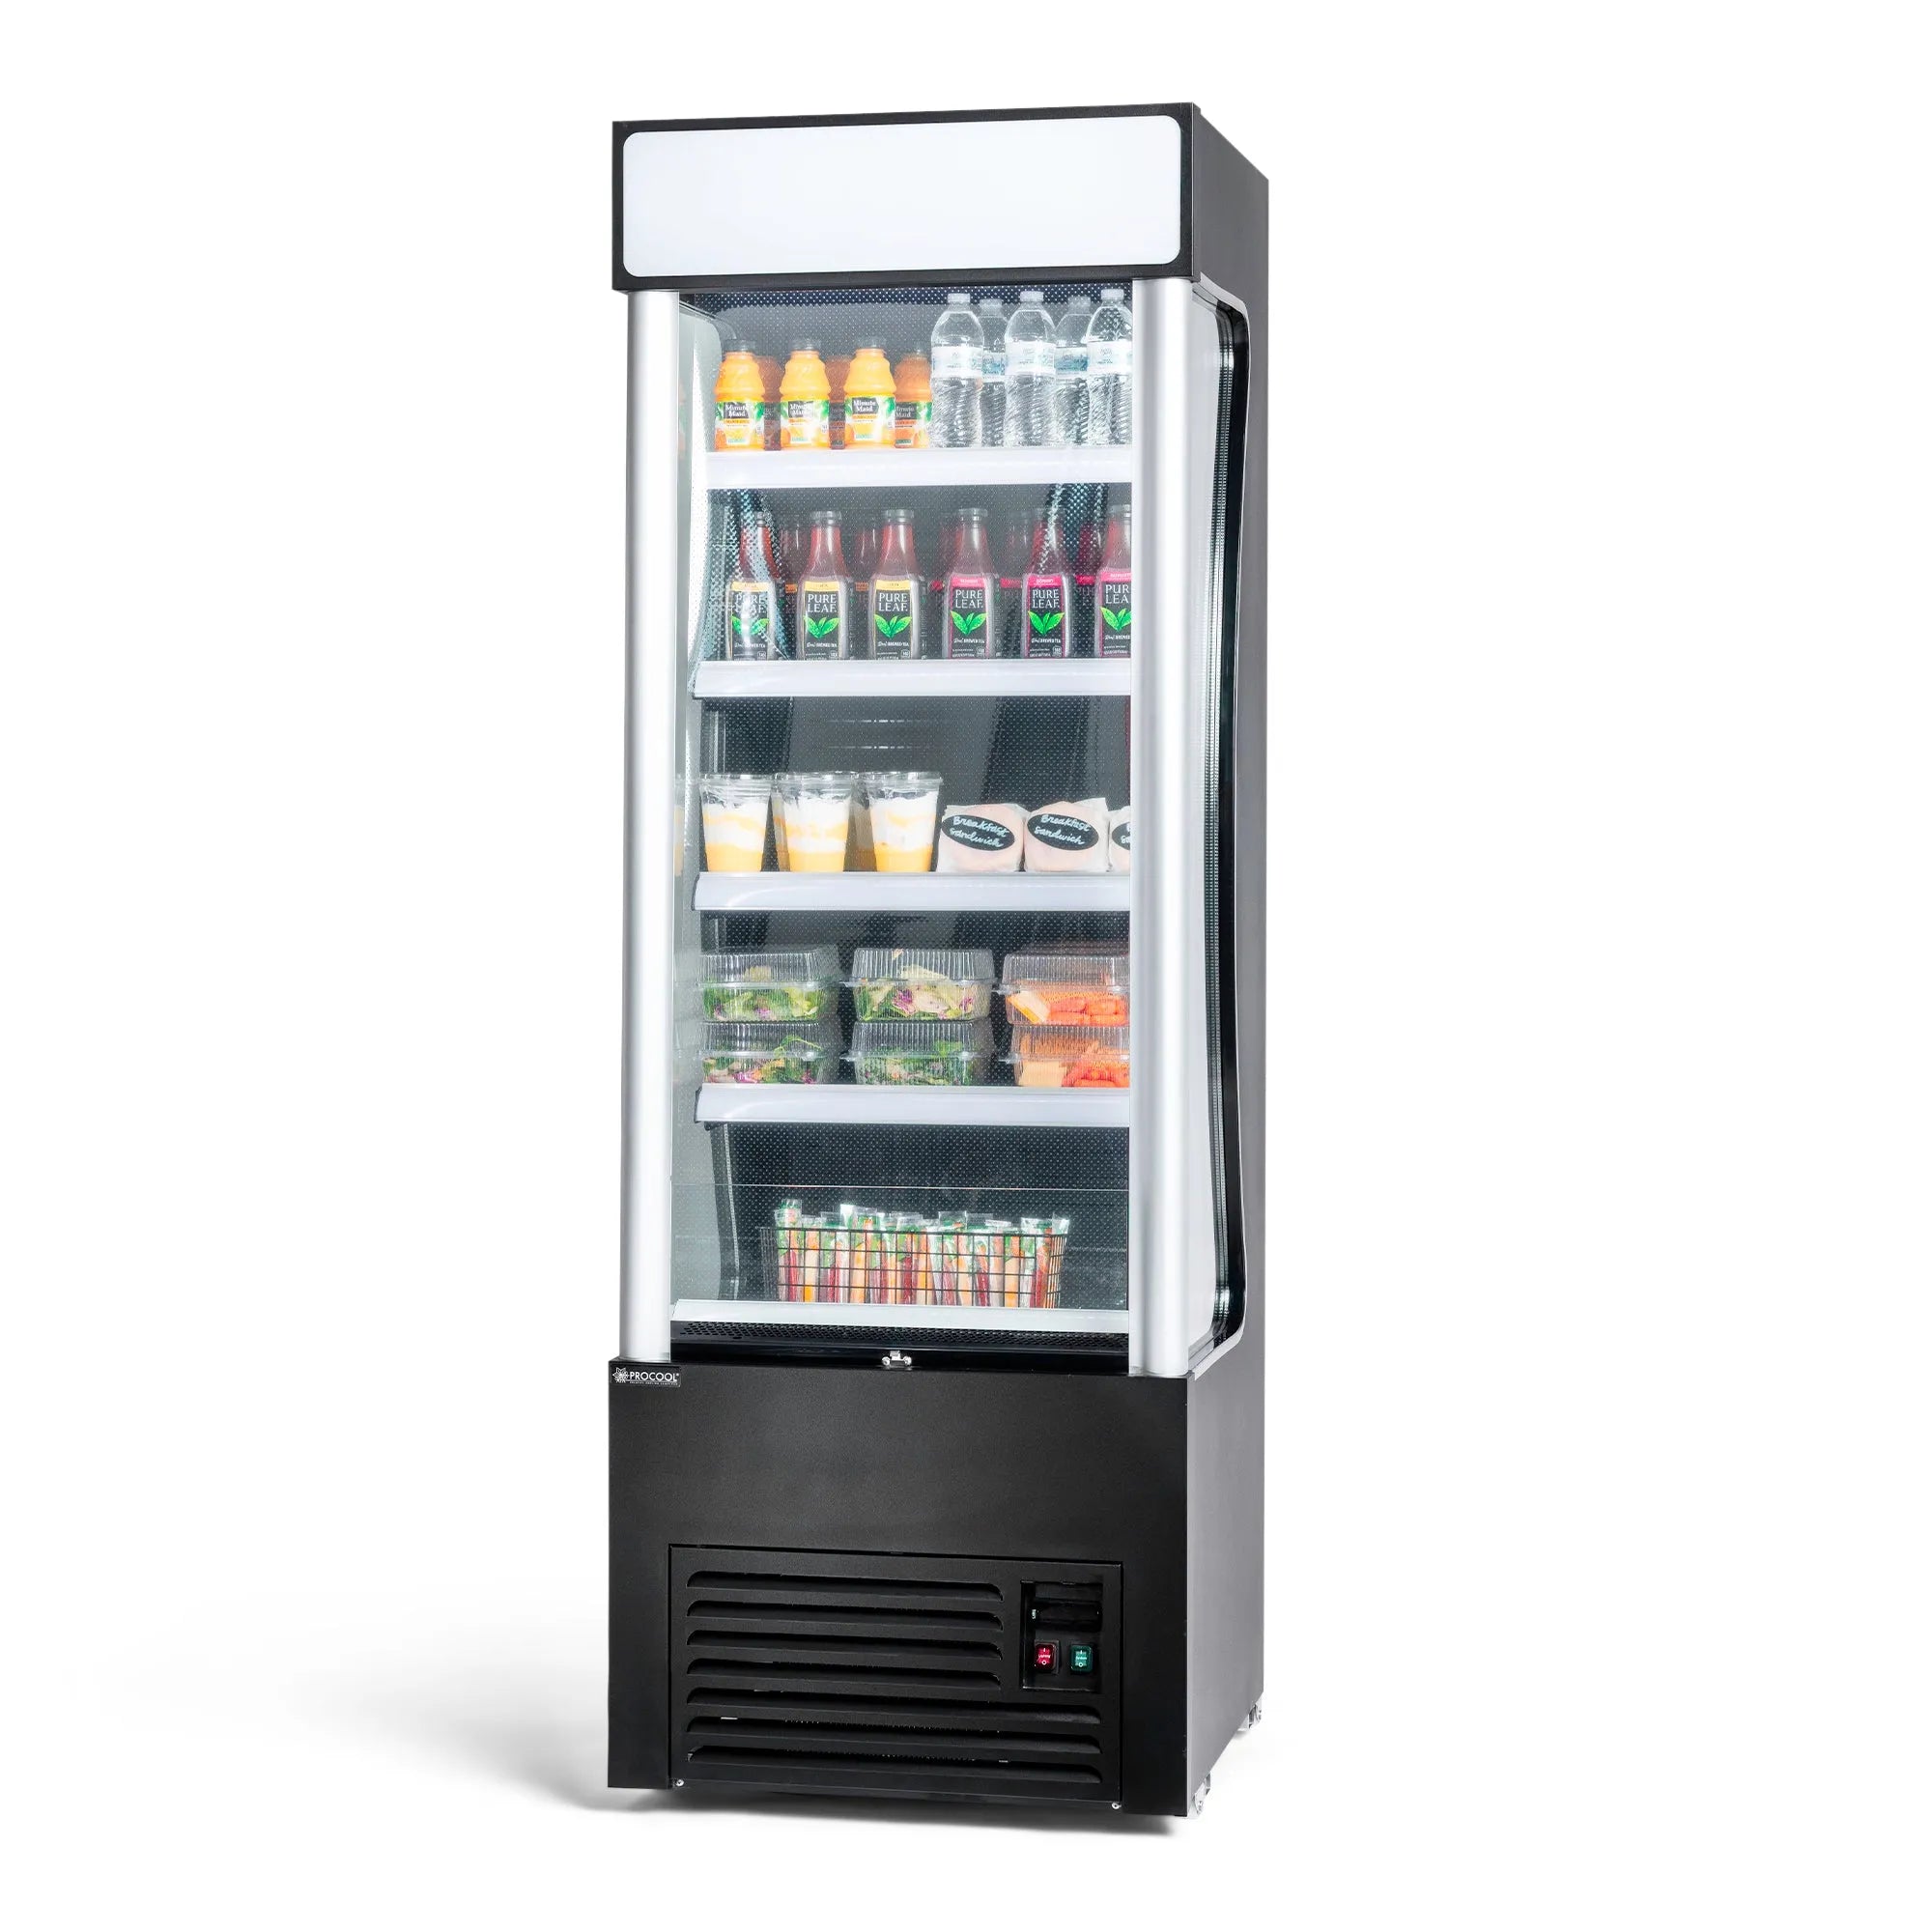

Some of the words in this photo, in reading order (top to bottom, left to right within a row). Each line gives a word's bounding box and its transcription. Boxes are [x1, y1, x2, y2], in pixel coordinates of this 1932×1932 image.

[955, 589, 983, 599] PURE
[1032, 589, 1060, 599] PURE
[1105, 583, 1130, 594] PUR
[808, 593, 837, 604] PURE
[879, 592, 908, 603] PURE
[1105, 594, 1129, 605] LEA
[952, 815, 1010, 838] Breakfast
[1040, 814, 1092, 832] Breakfast
